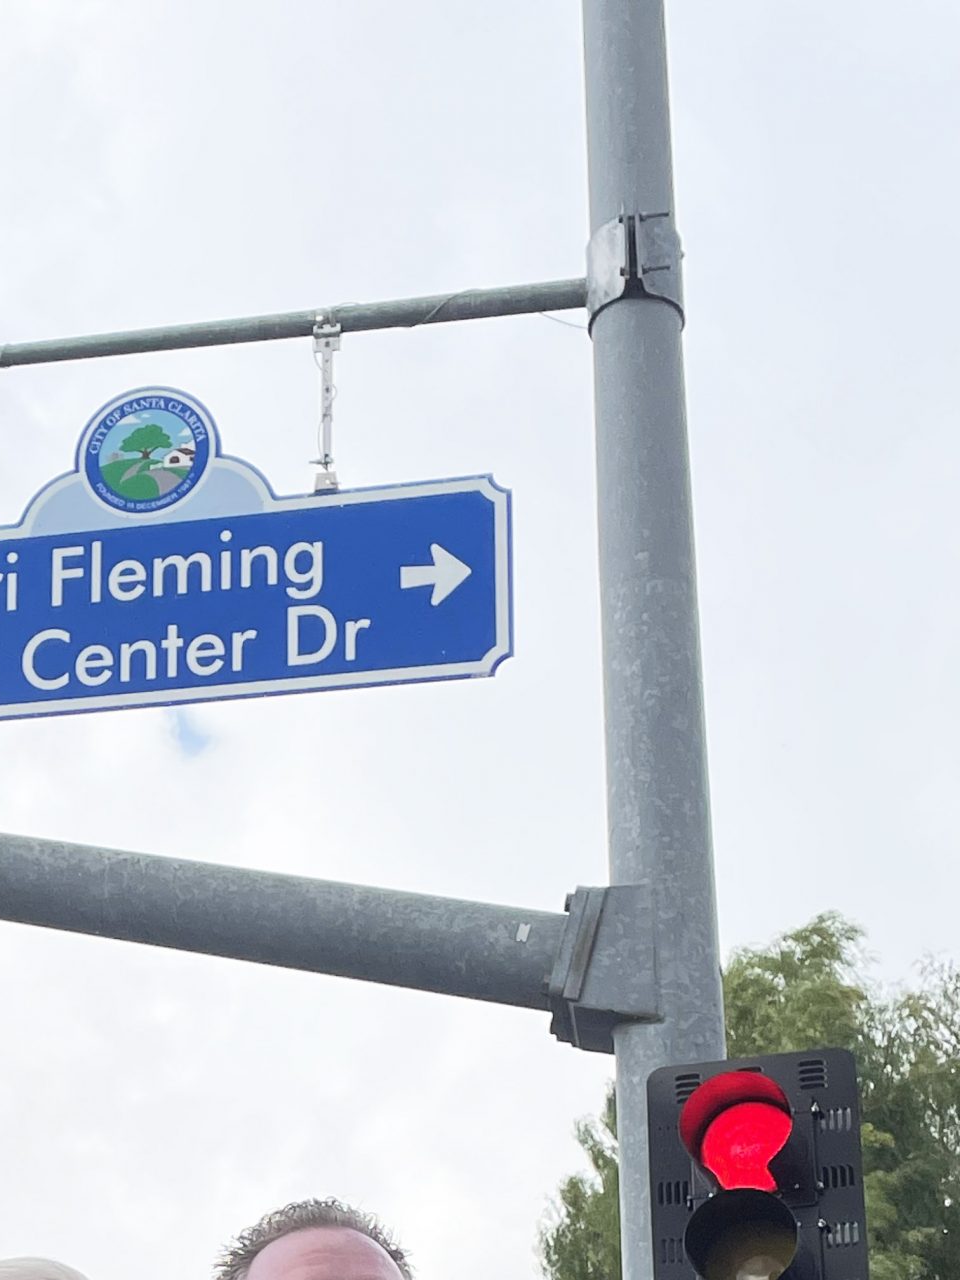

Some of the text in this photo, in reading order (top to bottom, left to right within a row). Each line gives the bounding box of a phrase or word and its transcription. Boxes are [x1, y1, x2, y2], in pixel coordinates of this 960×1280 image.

[90, 398, 207, 455] CITY OF SANTA CLARITA
[51, 530, 323, 607] Fleming
[22, 624, 258, 691] Center
[287, 604, 371, 666] Dr
